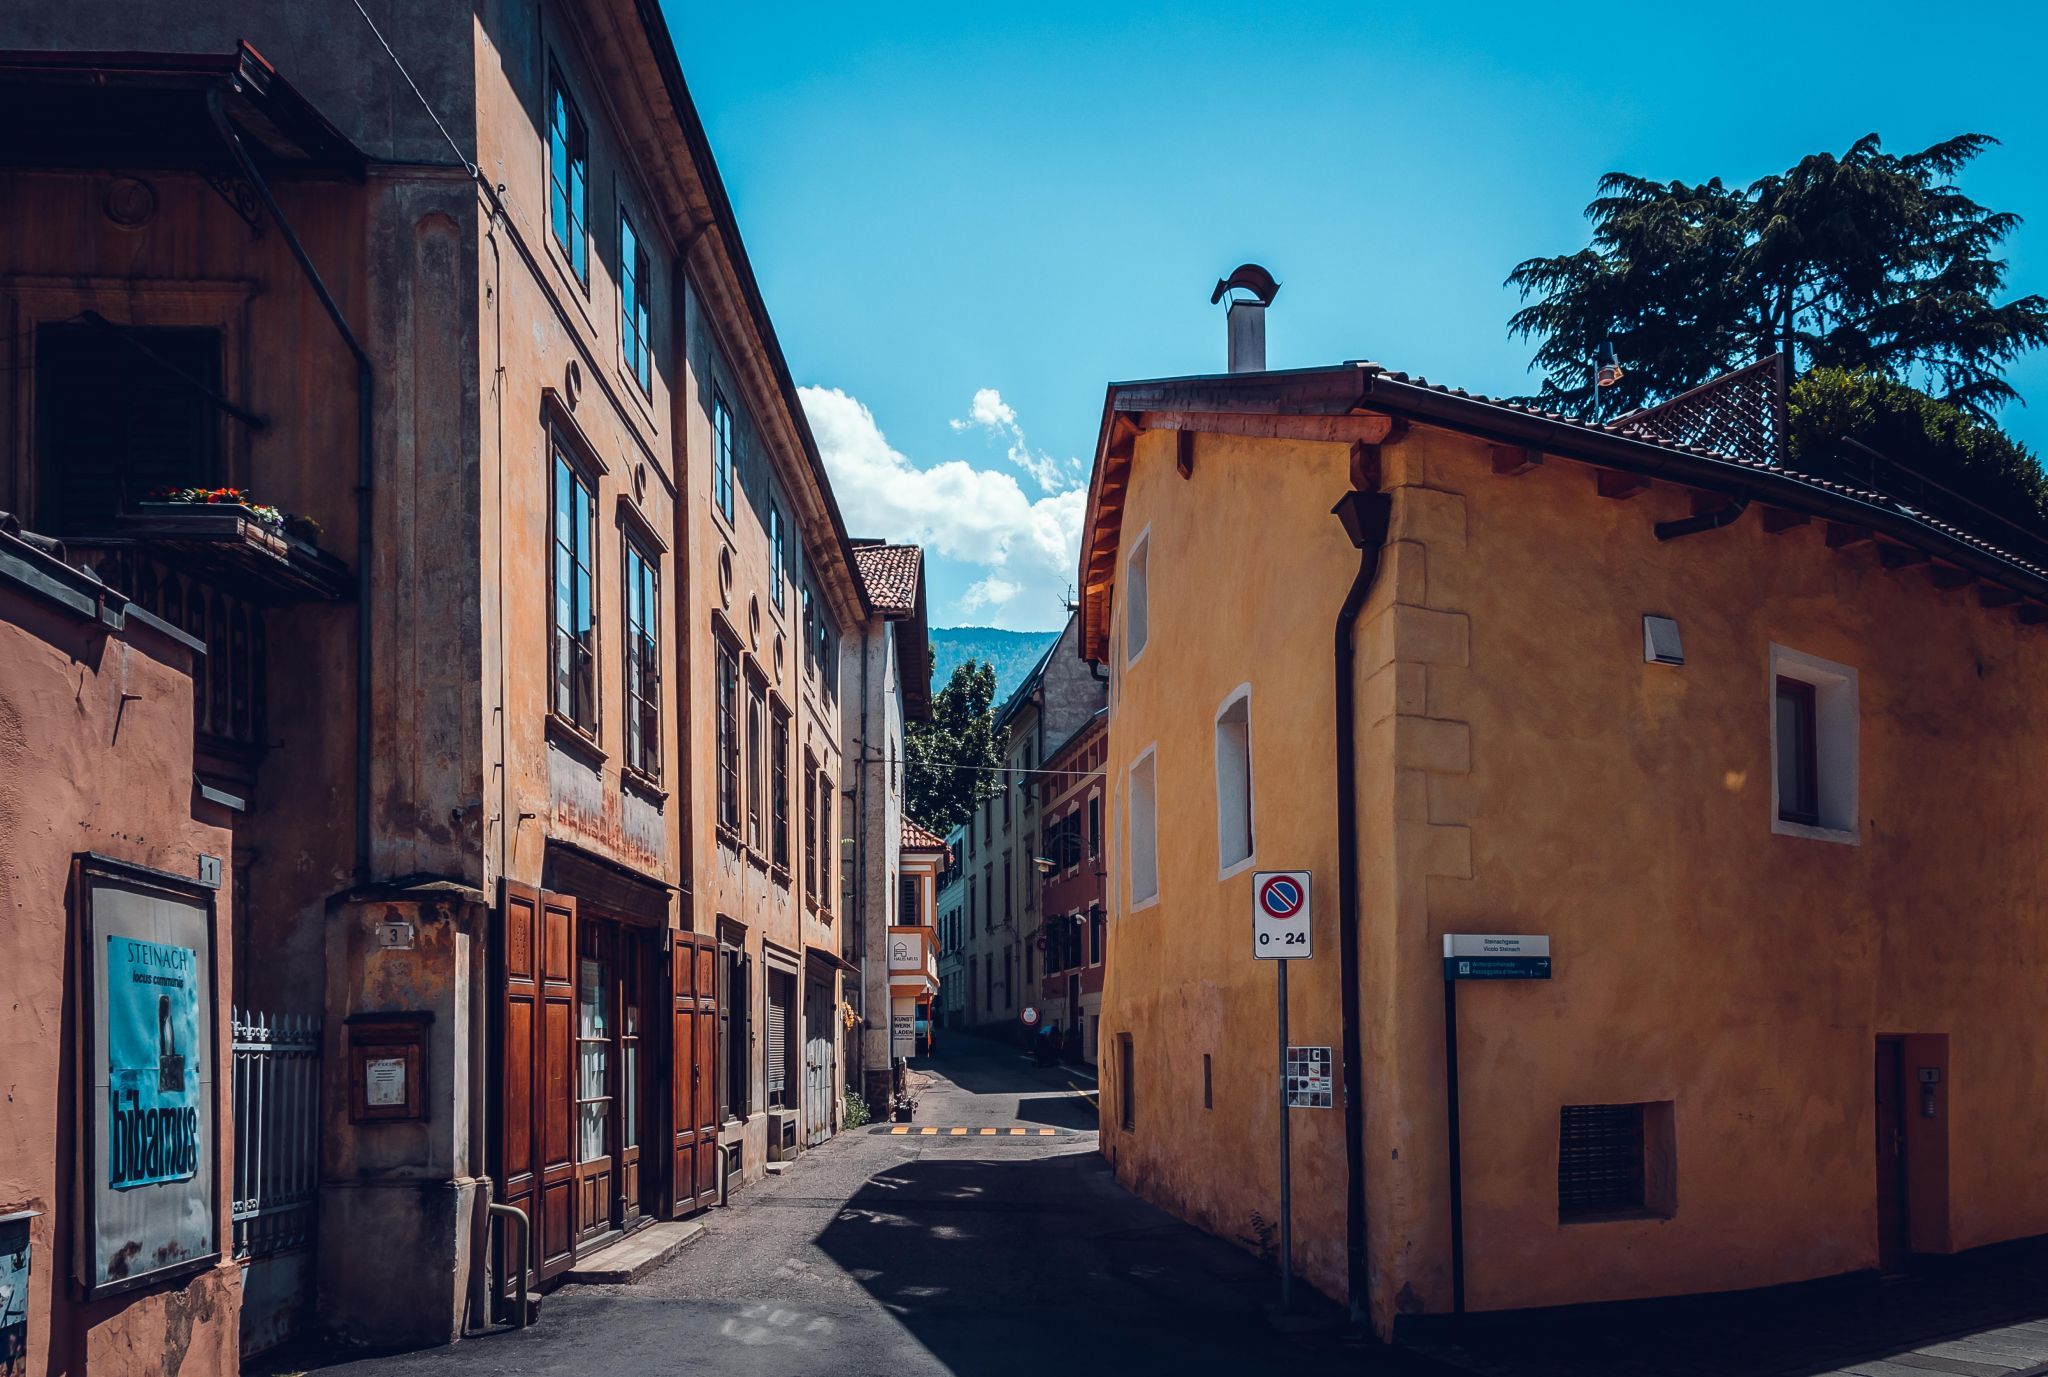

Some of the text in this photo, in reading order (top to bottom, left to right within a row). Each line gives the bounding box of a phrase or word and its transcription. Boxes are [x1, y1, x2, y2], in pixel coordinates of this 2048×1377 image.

[208, 862, 213, 881] 1
[390, 928, 398, 943] 3
[1259, 932, 1270, 945] 0
[1285, 932, 1306, 945] 24
[127, 942, 187, 971] STEINACH
[132, 970, 184, 988] locus communis
